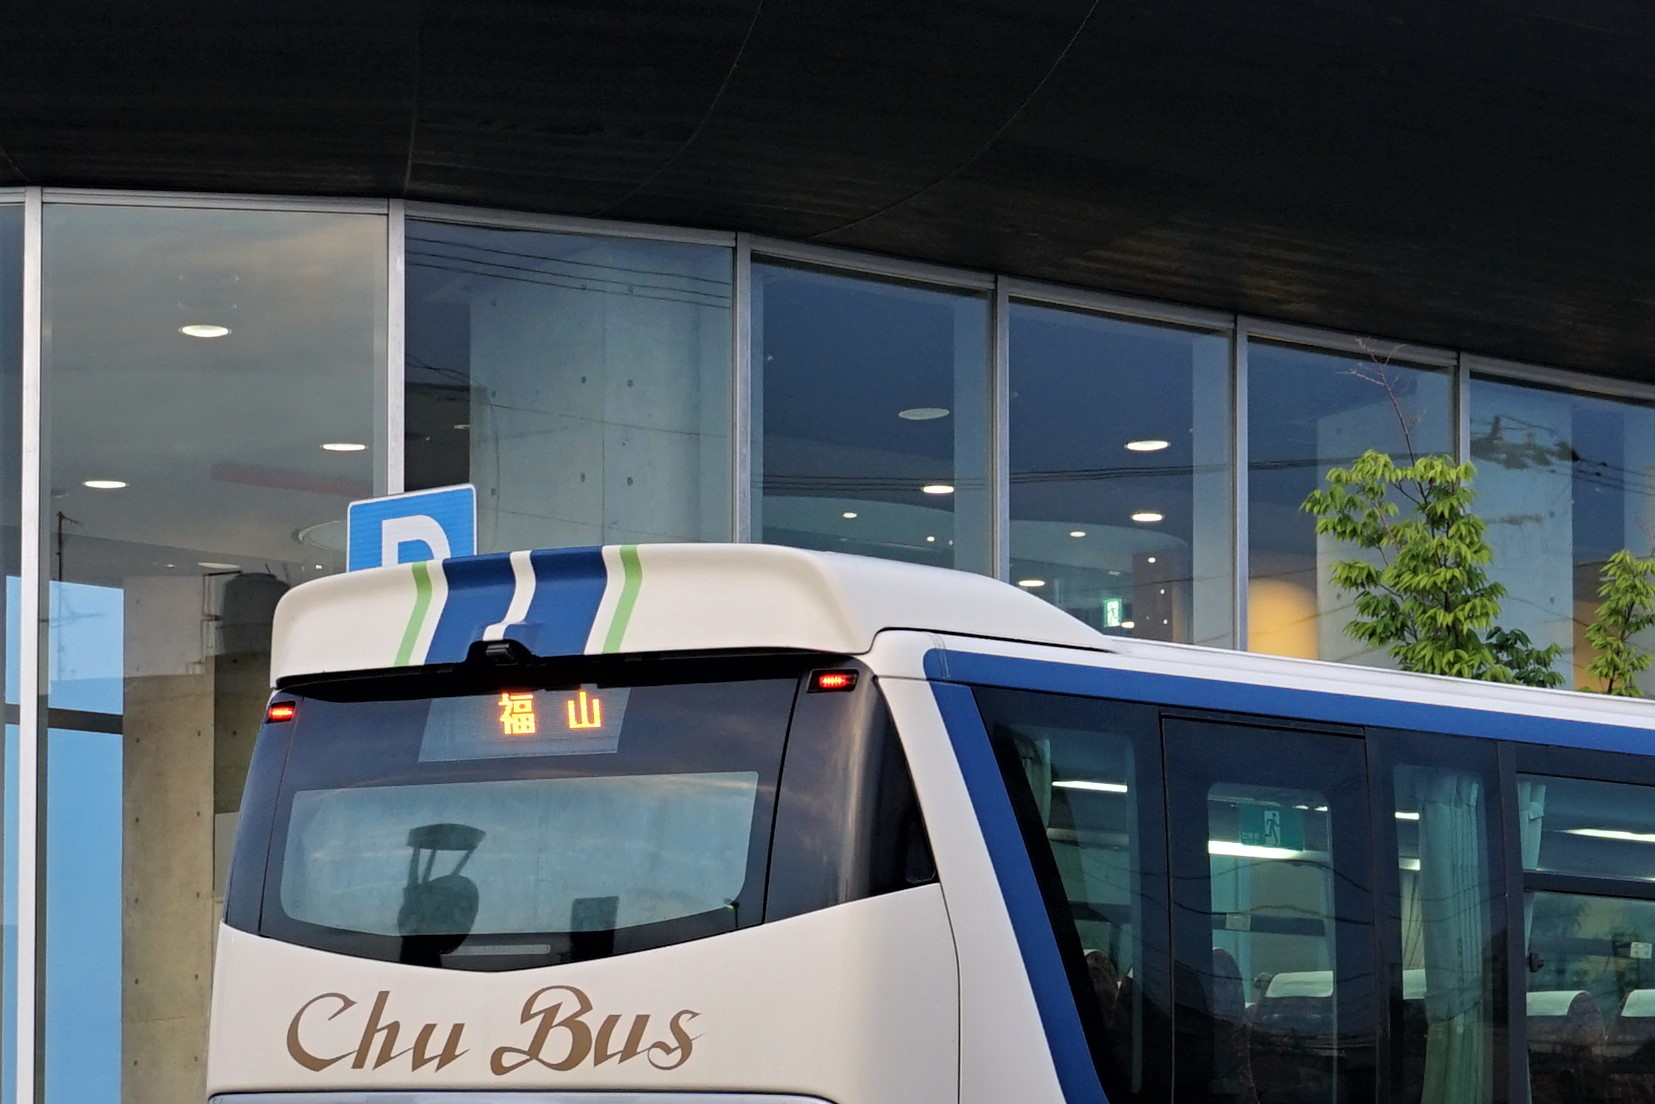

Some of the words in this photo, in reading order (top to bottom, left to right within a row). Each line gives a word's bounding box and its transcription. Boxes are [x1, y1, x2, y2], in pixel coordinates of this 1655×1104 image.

[498, 692, 602, 735] 福山
[286, 990, 470, 1074] Chu
[490, 985, 704, 1076] Bus
